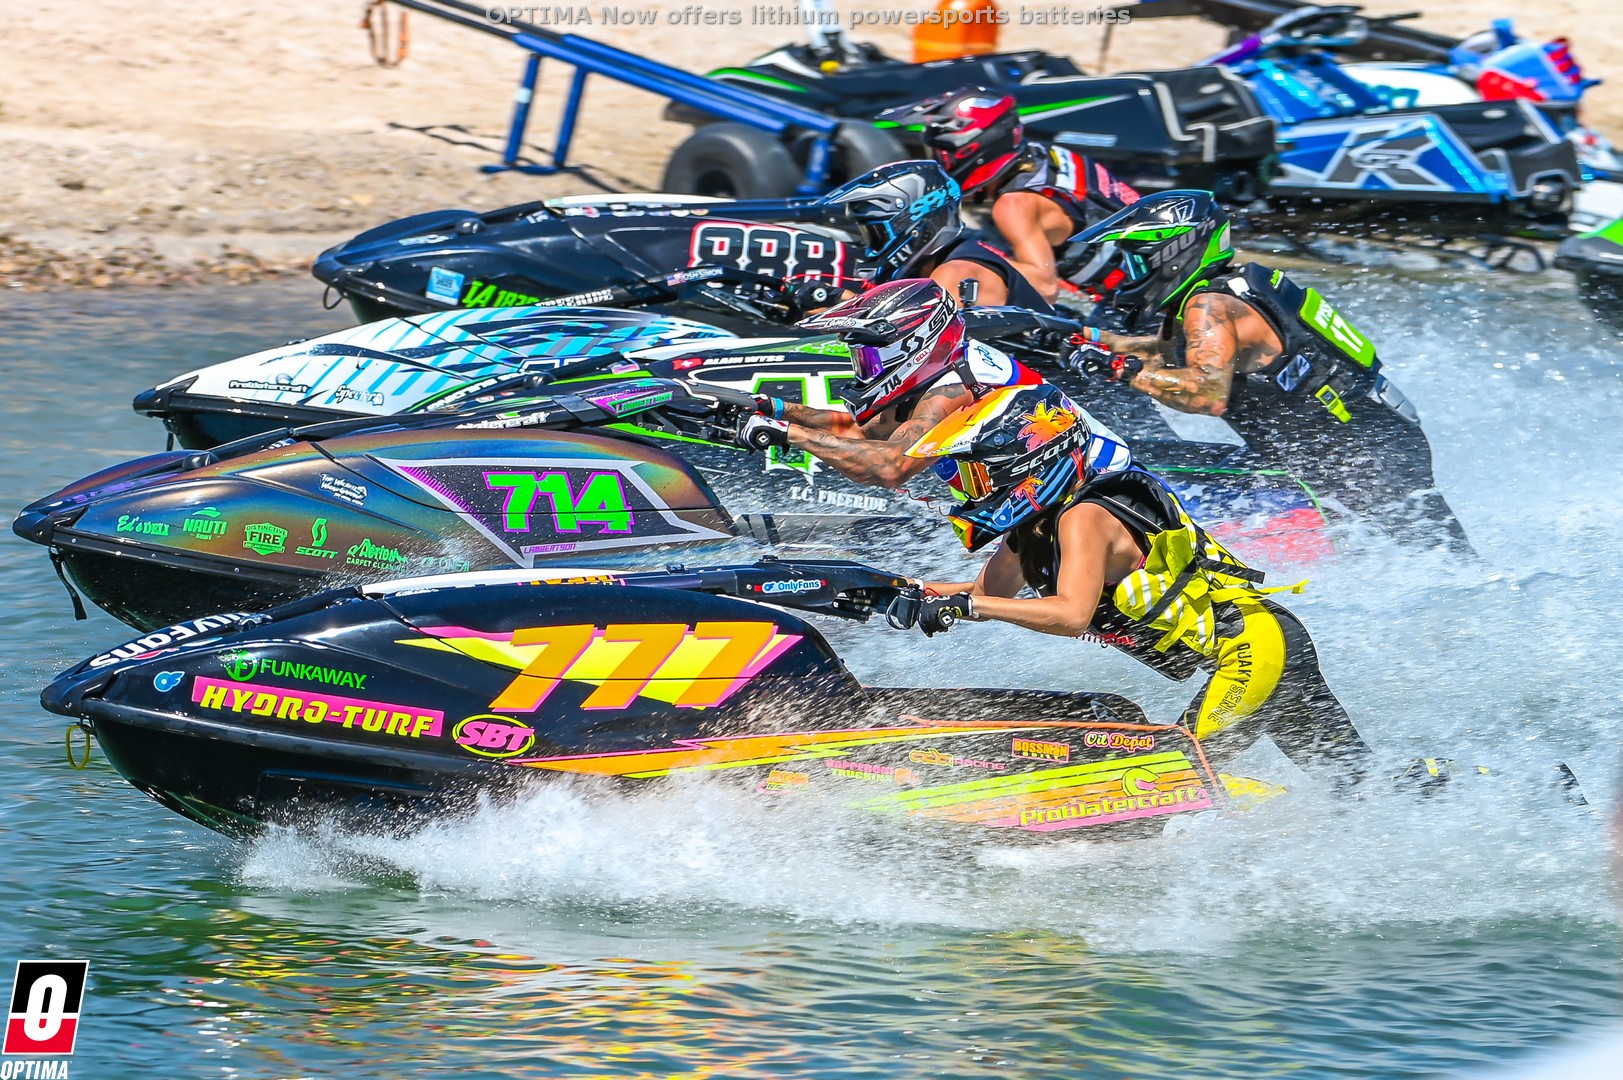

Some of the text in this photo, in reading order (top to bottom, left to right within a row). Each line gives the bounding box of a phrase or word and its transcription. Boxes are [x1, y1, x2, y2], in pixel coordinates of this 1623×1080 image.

[703, 355, 785, 366] ALAIN WYSS
[915, 349, 931, 364] BELL
[881, 374, 903, 397] 714
[482, 471, 635, 534] 714
[182, 518, 228, 535] NAUTI
[246, 523, 288, 537] DISTINCTIVE
[250, 532, 281, 545] FIRE
[295, 546, 339, 559] SCOTT
[523, 543, 577, 555] LAMBERTSON
[346, 557, 372, 567] CARPET
[777, 579, 820, 592] OnlyFans
[260, 658, 367, 690] FUNKAWAY
[487, 621, 780, 713] 777
[199, 685, 434, 738] HYDRO-TURF
[455, 720, 536, 751] SBT
[1087, 732, 1154, 750] Oil Depot
[1019, 785, 1197, 826] ProWatercraft
